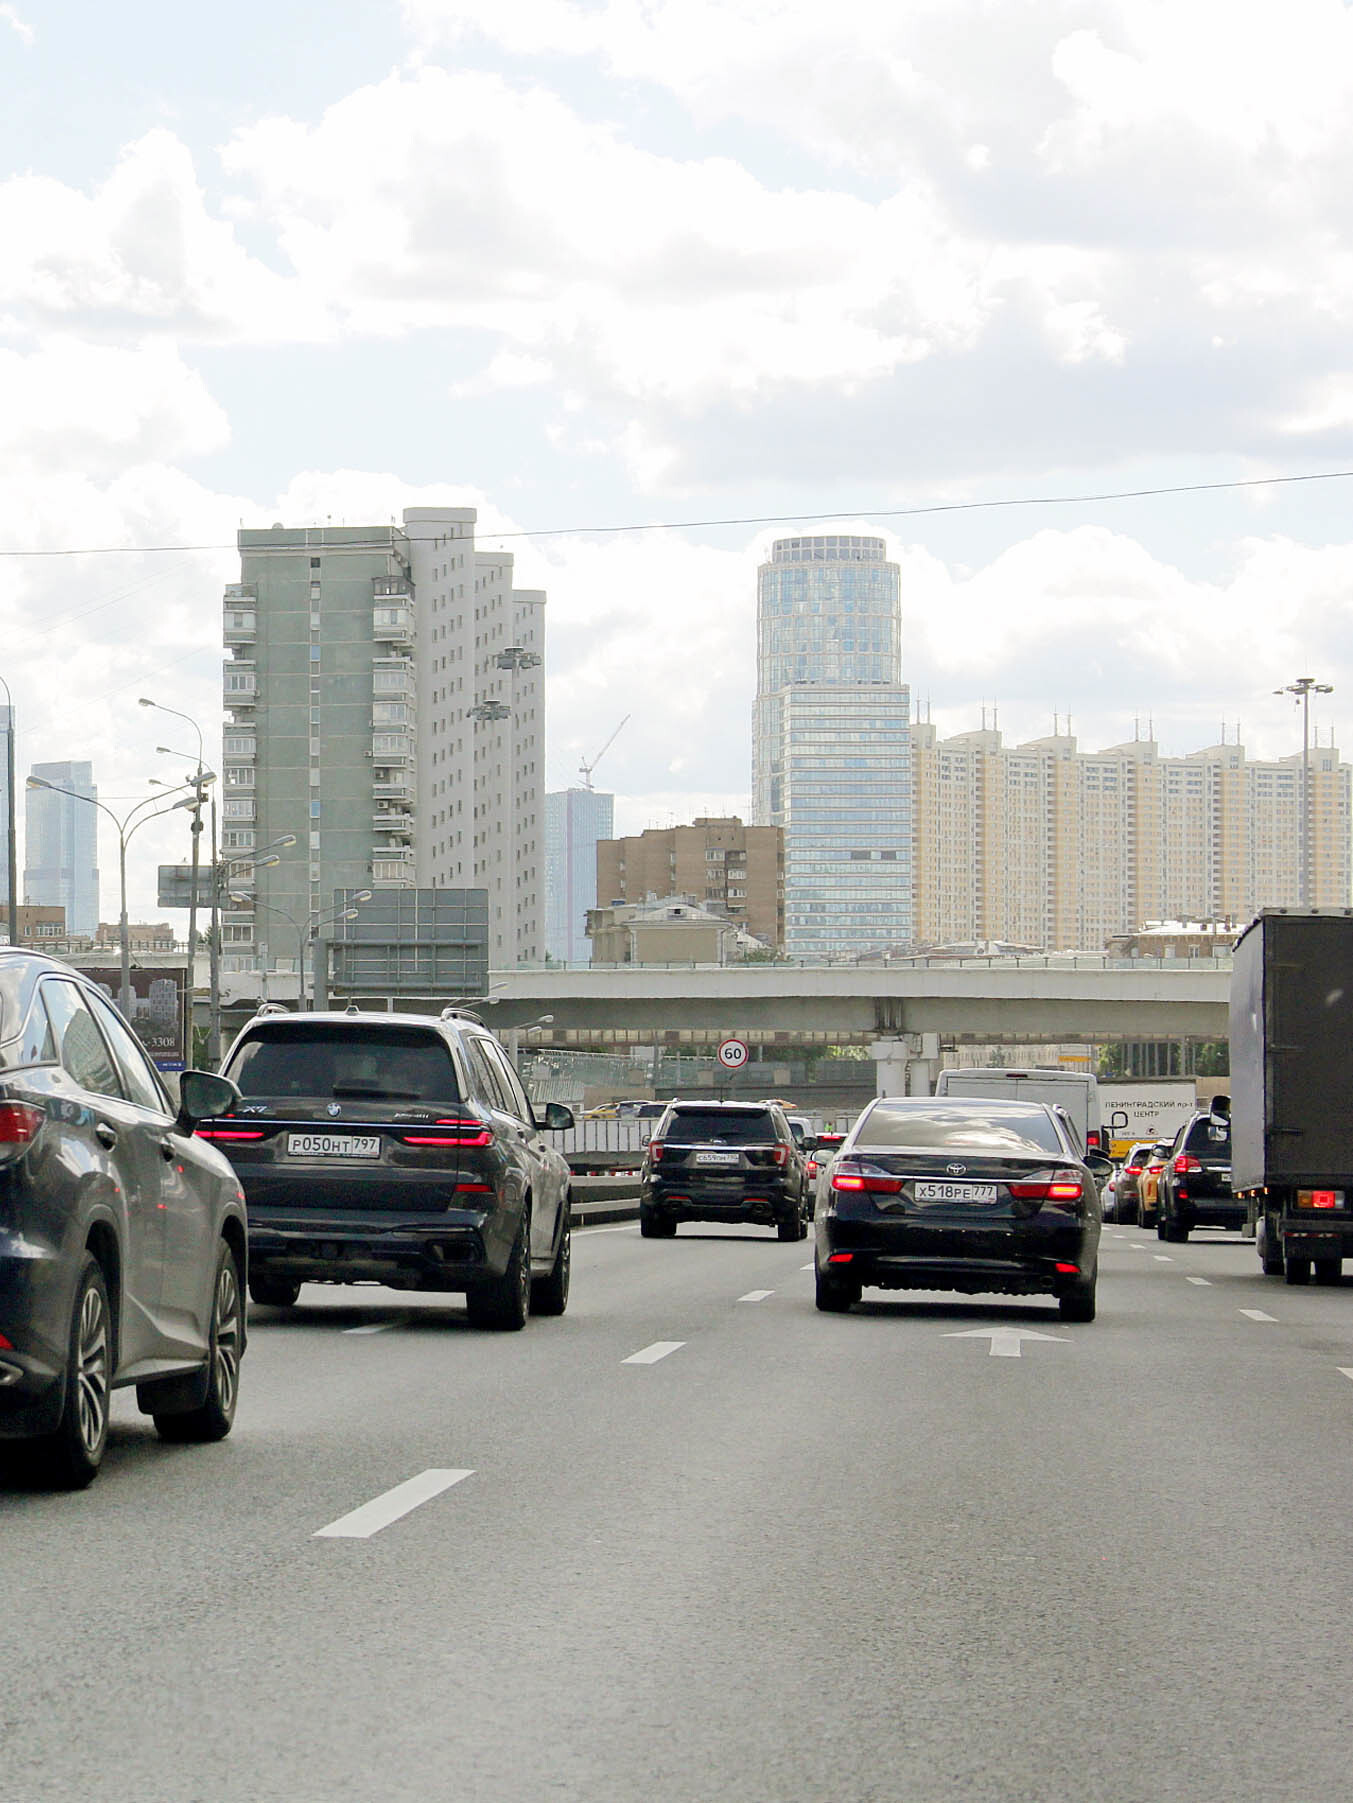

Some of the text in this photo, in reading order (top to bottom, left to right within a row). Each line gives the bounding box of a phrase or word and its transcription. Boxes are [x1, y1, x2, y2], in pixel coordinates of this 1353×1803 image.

[724, 1047, 742, 1060] 60
[1105, 1101, 1175, 1109] ЛЕНИНГРАДСКИЙ
[292, 1136, 376, 1153] Р050НТ 797
[919, 1184, 993, 1199] Х518РЕ 777
